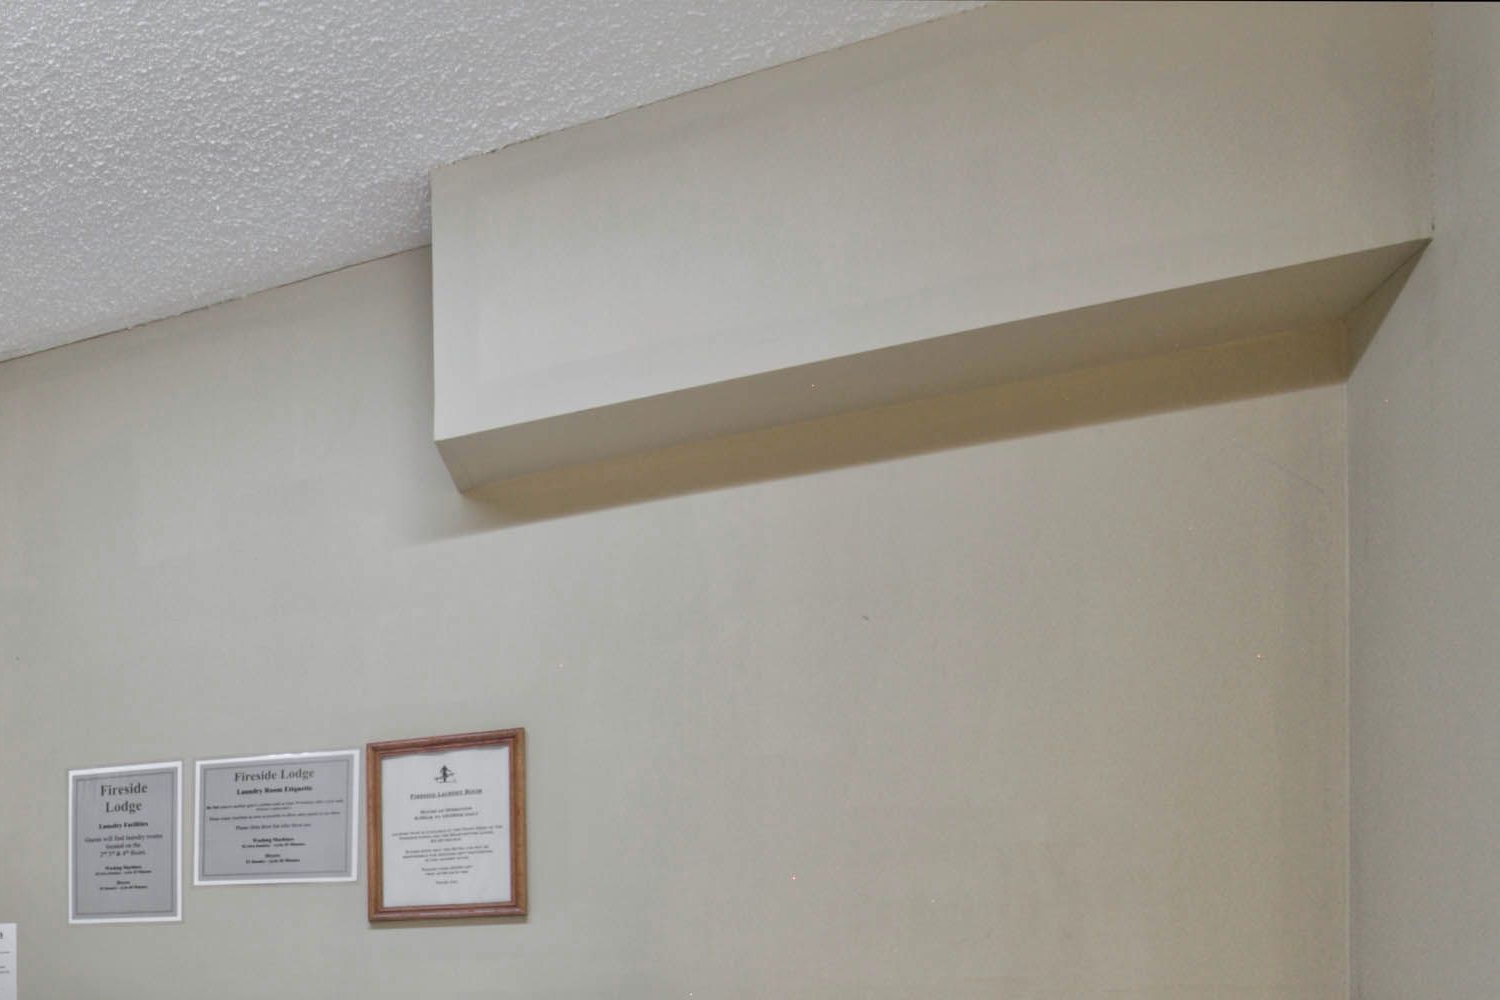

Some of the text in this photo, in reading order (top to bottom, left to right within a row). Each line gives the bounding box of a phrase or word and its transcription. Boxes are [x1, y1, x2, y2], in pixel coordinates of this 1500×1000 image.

[234, 768, 315, 782] Fireside Lodge
[101, 783, 148, 814] Fireside Lodge
[237, 787, 262, 797] Laundry
[264, 786, 283, 794] Room
